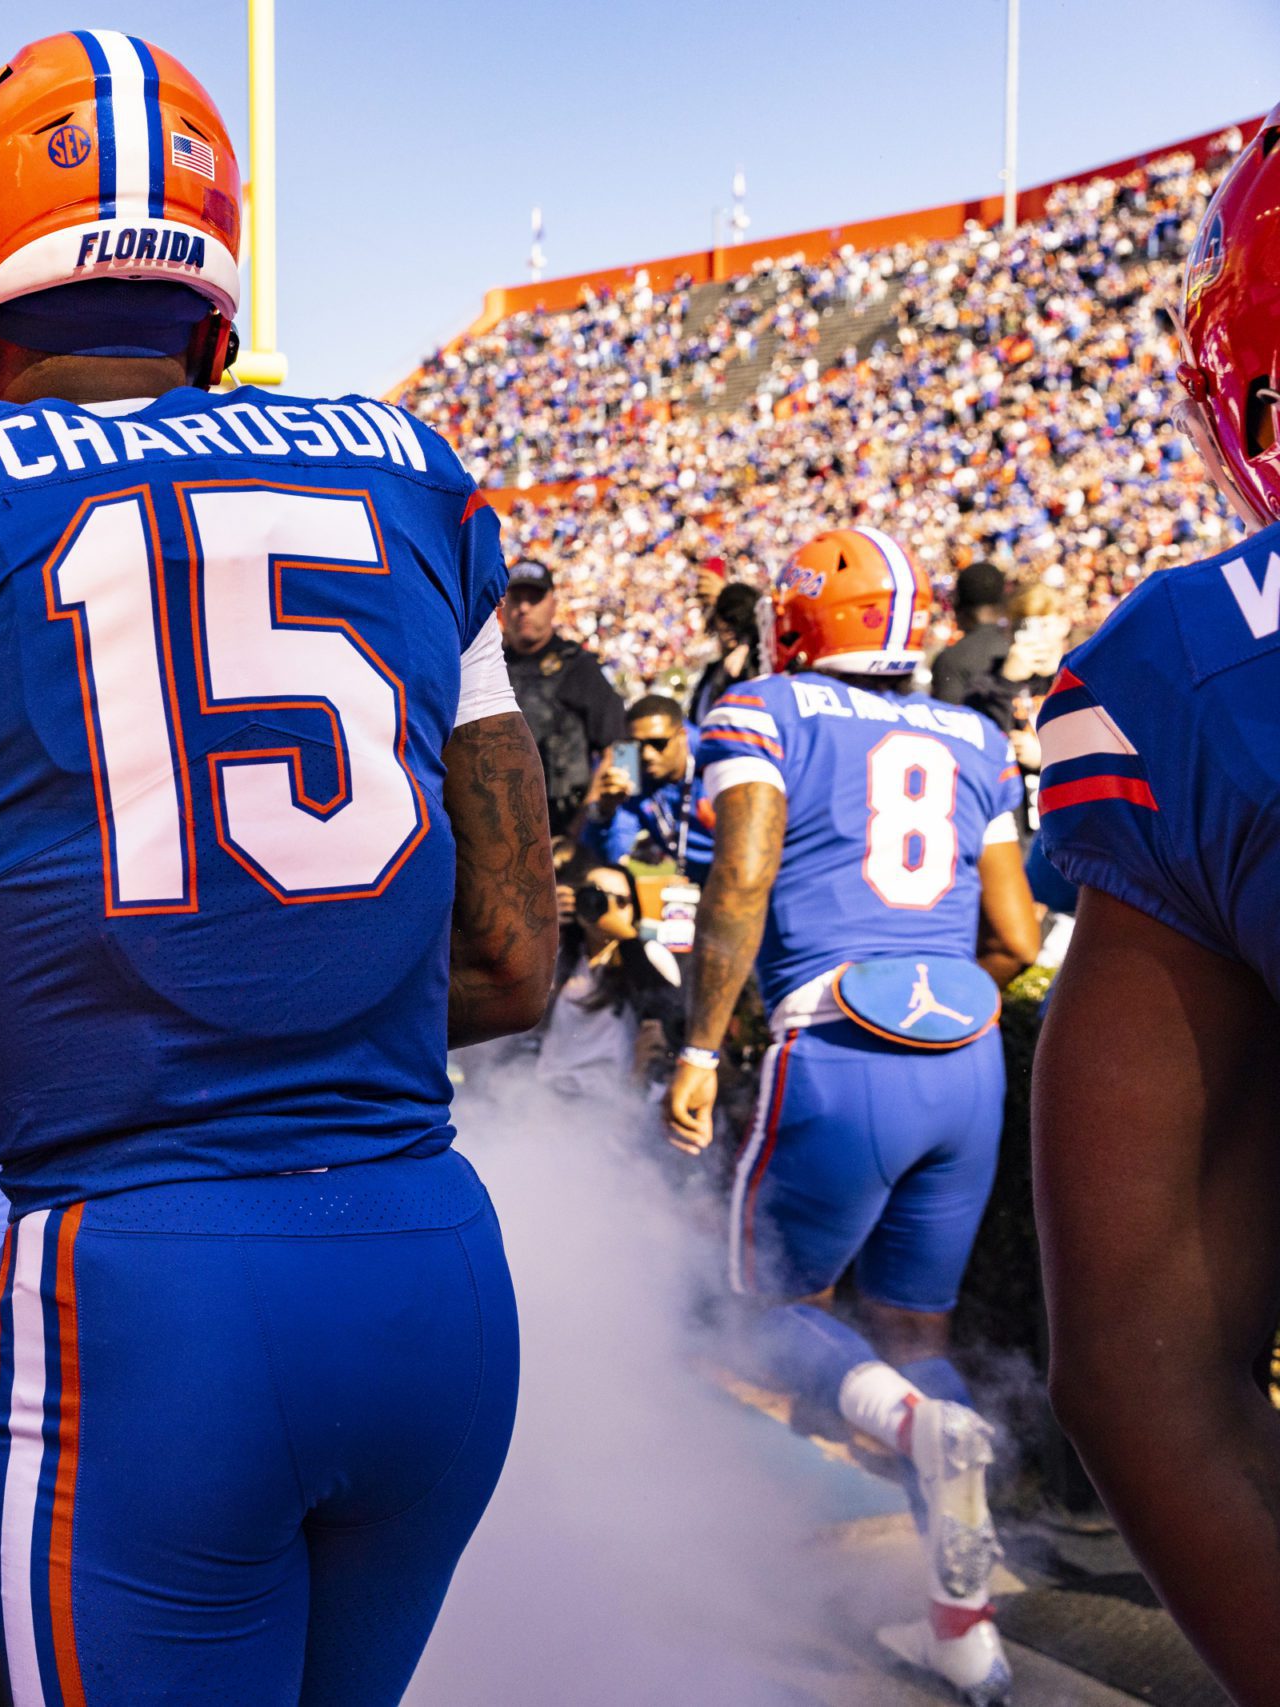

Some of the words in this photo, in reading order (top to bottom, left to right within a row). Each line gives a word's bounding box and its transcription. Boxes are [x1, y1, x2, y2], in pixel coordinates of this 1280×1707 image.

[50, 127, 90, 166] SEC
[77, 228, 206, 269] FLORIDA
[43, 479, 430, 917] 15
[862, 730, 960, 911] 8
